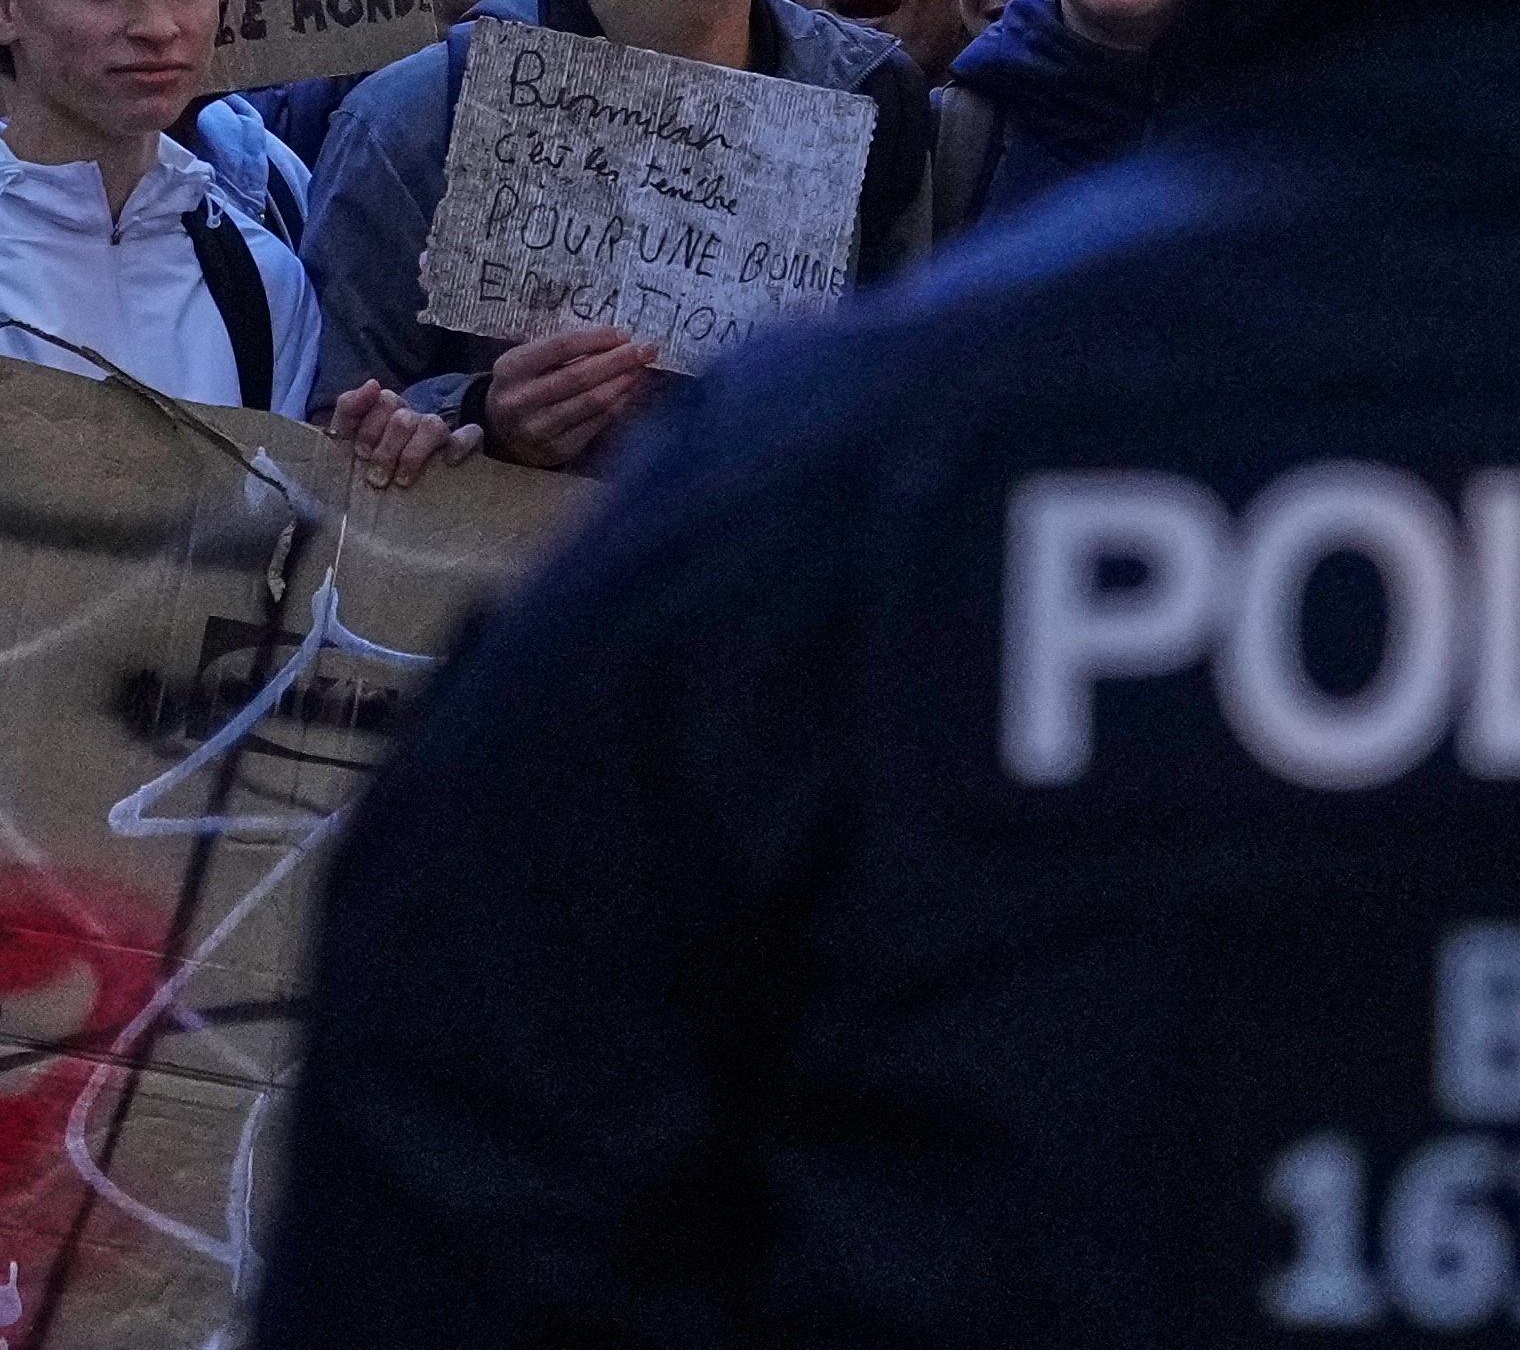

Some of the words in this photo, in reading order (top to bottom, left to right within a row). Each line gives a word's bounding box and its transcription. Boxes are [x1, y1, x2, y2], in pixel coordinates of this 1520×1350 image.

[485, 184, 625, 262] POUR
[638, 224, 723, 279] UNE
[739, 241, 847, 299] BONNE
